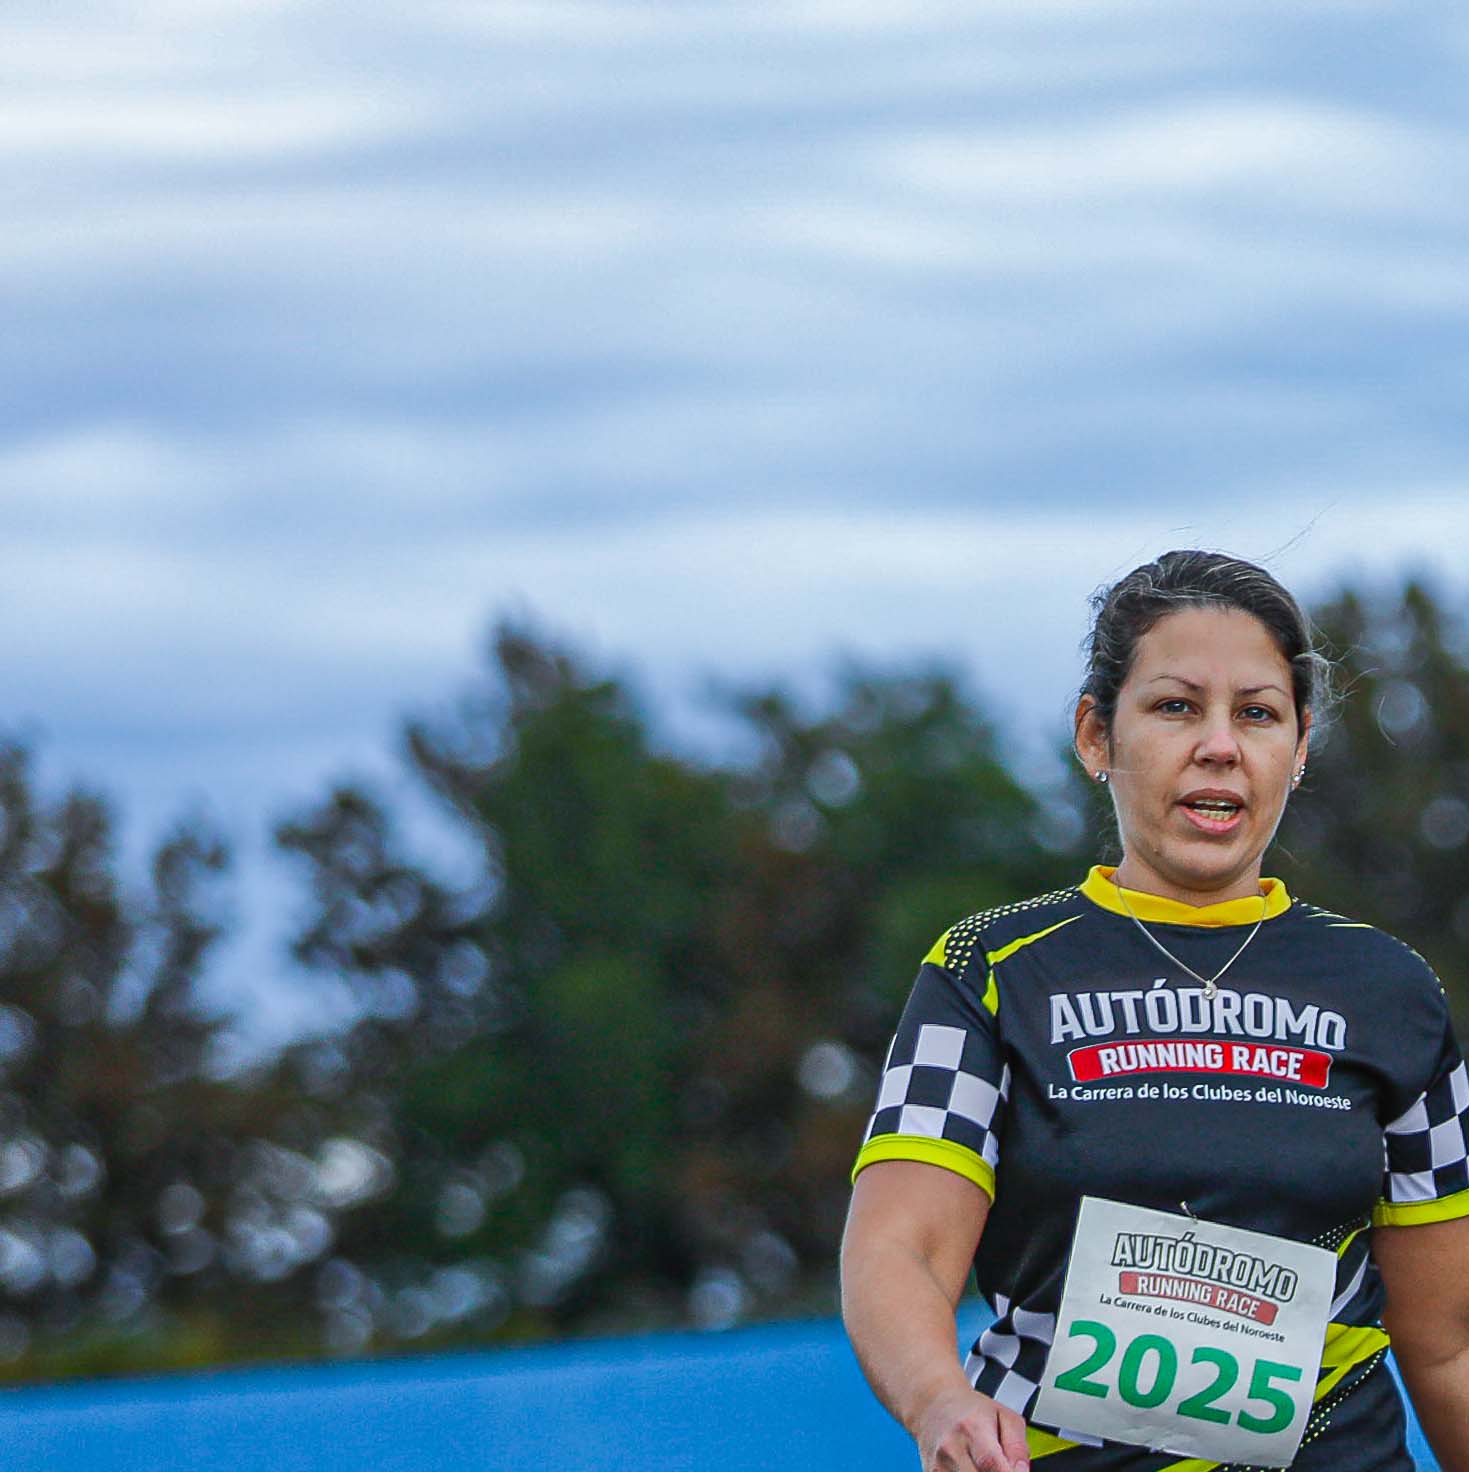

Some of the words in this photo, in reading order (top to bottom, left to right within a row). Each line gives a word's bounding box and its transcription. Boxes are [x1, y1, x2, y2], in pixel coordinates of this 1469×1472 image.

[1050, 978, 1347, 1051] AUTÓDROMO
[1097, 1044, 1224, 1076] RUNNING
[1231, 1047, 1304, 1080] RACE
[1049, 1083, 1068, 1100] La
[1071, 1084, 1134, 1101] Carrera
[1137, 1083, 1161, 1099] de
[1163, 1083, 1188, 1100] los
[1191, 1084, 1252, 1102] Clubes
[1255, 1084, 1283, 1104] del
[1285, 1089, 1352, 1111] Noroeste
[1111, 1232, 1298, 1303] AUTÓDROMO
[1100, 1293, 1112, 1305] La
[1114, 1296, 1152, 1314] Carrera
[1154, 1303, 1168, 1317] de
[1170, 1306, 1185, 1321] los
[1187, 1311, 1221, 1329] Clubes
[1223, 1320, 1240, 1334] del
[1241, 1324, 1286, 1343] Noroeste
[1136, 1275, 1213, 1302] RUNNING
[1216, 1287, 1261, 1319] RACE
[1054, 1319, 1303, 1434] 2025
